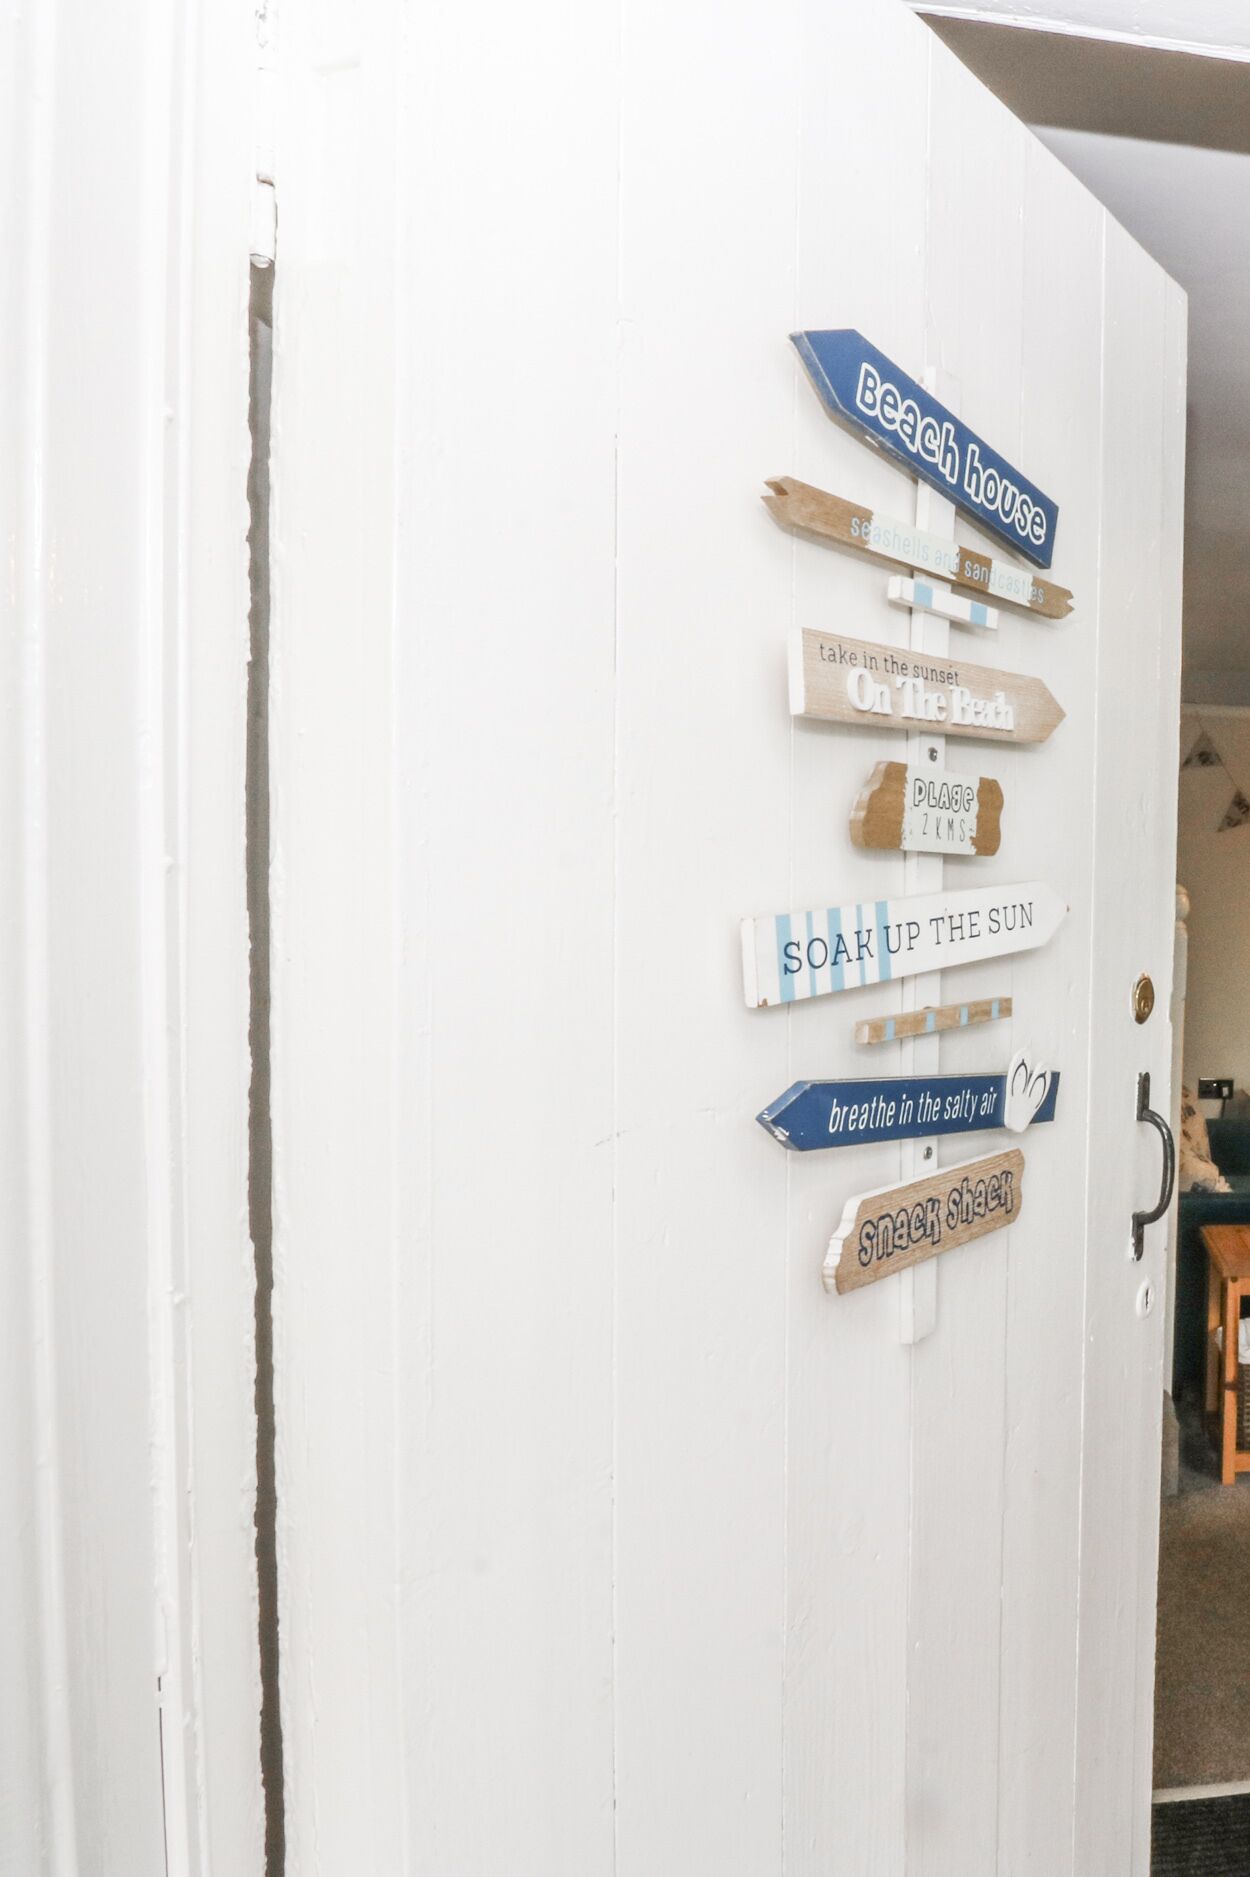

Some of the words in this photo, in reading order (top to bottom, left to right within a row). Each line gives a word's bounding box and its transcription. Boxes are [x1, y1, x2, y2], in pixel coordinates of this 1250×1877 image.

[856, 362, 959, 484] Beach
[964, 443, 1047, 545] house
[850, 517, 930, 563] seashells
[934, 547, 960, 573] and
[964, 558, 1045, 604] sandcastles
[819, 643, 858, 666] take
[863, 650, 878, 671] in
[884, 654, 909, 677] the
[913, 665, 960, 687] sunset
[847, 667, 892, 715] On
[896, 676, 947, 721] The
[948, 685, 1015, 731] Beach
[782, 928, 875, 976] SOAK
[883, 920, 921, 954] UP
[929, 910, 981, 945] THE
[988, 902, 1035, 935] SUN
[828, 1094, 895, 1134] breathe
[898, 1093, 914, 1126] in
[916, 1091, 941, 1122] the
[943, 1088, 979, 1124] salty
[979, 1086, 998, 1116] air
